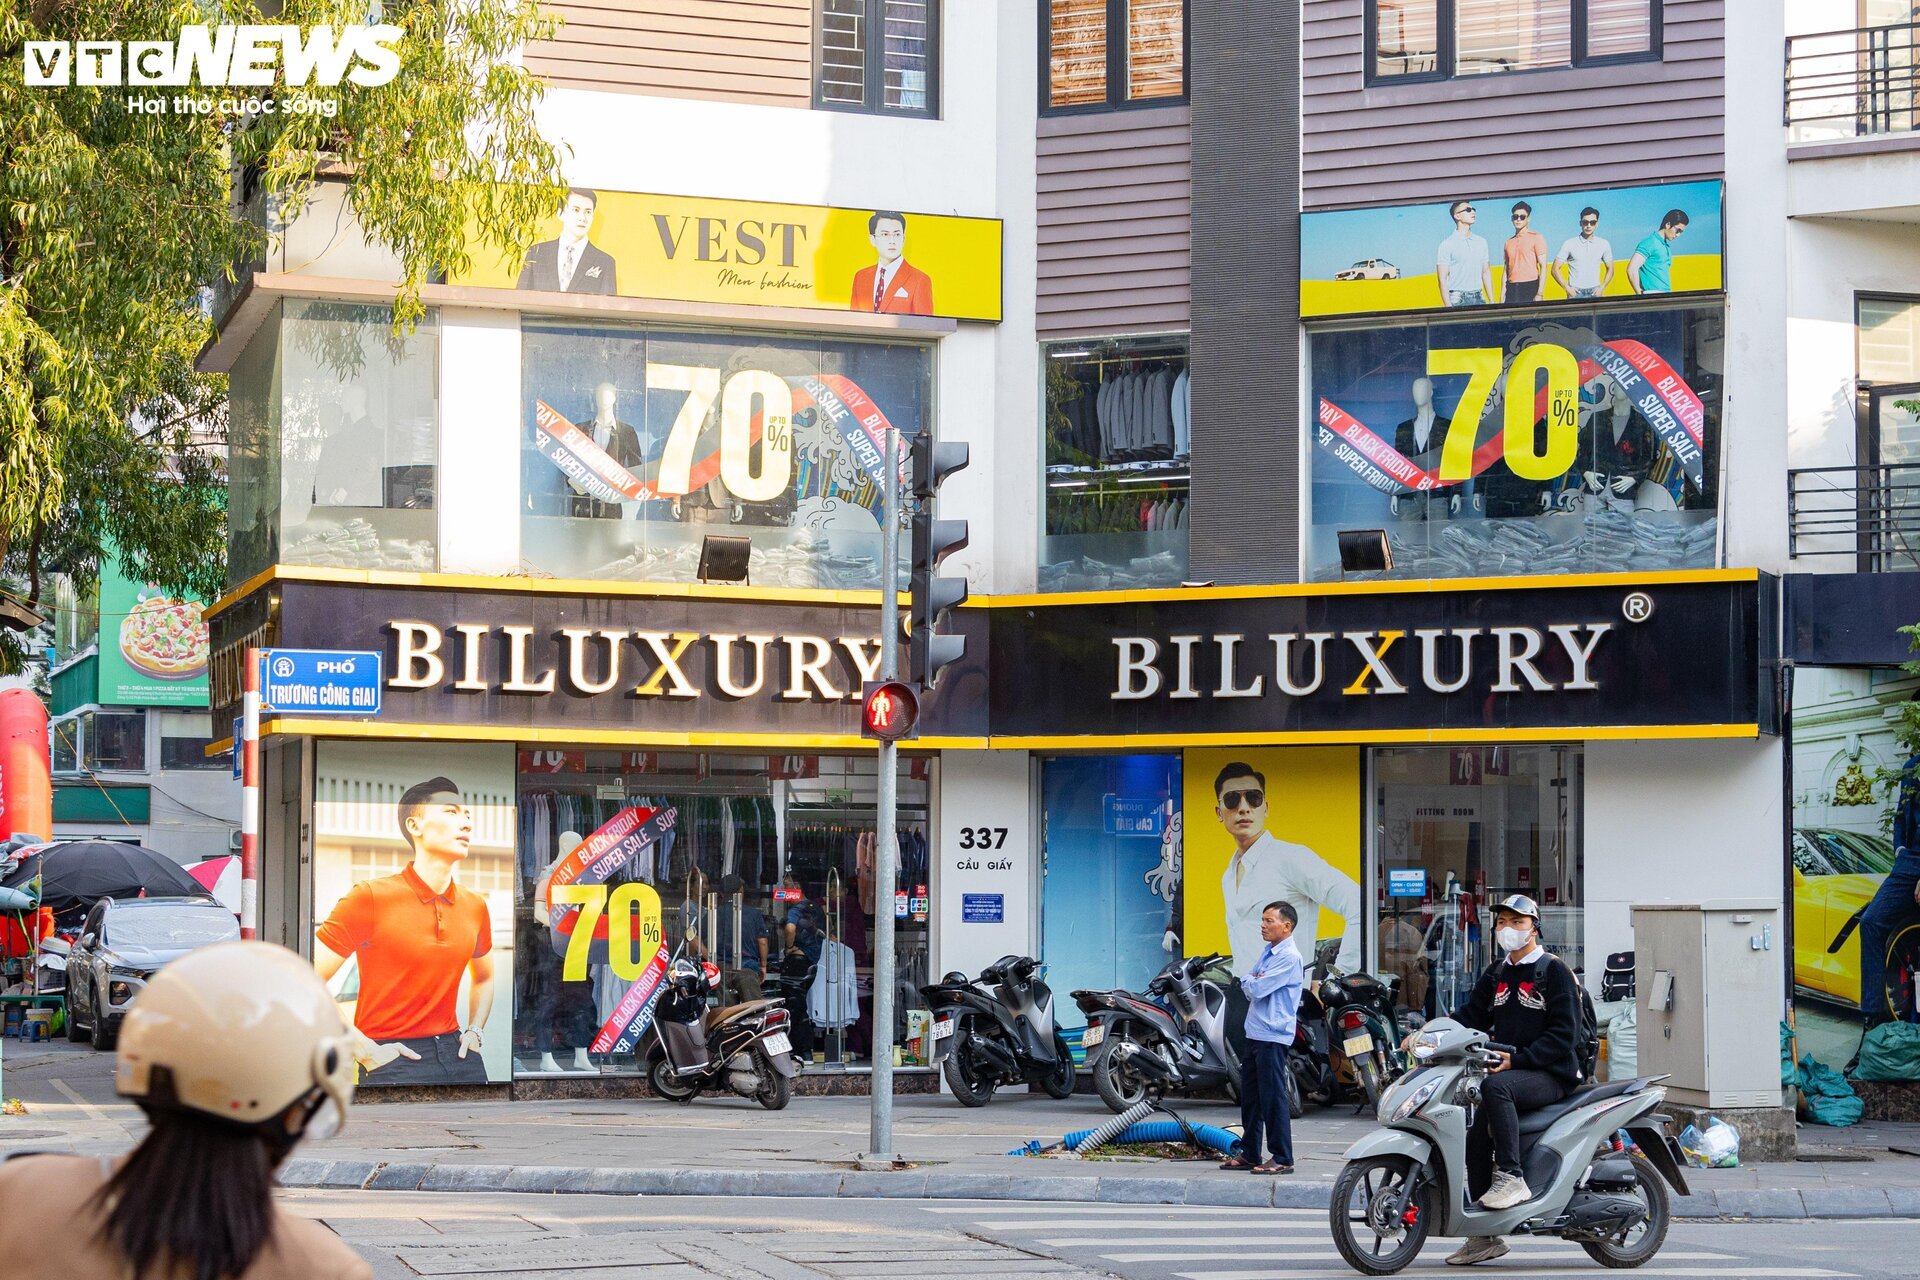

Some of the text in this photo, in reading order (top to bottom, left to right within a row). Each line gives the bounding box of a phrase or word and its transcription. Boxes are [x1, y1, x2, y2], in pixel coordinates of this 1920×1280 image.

[650, 214, 807, 268] VEST
[717, 268, 813, 290] Men fashion
[1426, 343, 1580, 481] 70
[1607, 358, 1641, 390] SALE
[1638, 394, 1676, 435] SUPER
[1667, 430, 1701, 464] SALE
[1656, 375, 1695, 415] BLACK
[645, 363, 792, 501] 70
[818, 391, 849, 422] SALE
[846, 428, 881, 468] SUPER
[1343, 424, 1383, 457] BLACK
[1377, 449, 1418, 482] FRIDAY
[550, 447, 585, 479] SUPER
[579, 474, 621, 501] FRIDAY
[1335, 443, 1369, 473] SUPER
[1362, 465, 1403, 495] FRIDAY
[317, 657, 357, 674] PHỐ
[387, 620, 884, 701] BILUXURY
[1110, 623, 1614, 700] BILUXURY
[271, 682, 376, 707] TRƯƠNG CÔNG GIAI
[1457, 752, 1473, 780] 70
[577, 832, 610, 867] BLACK
[606, 808, 641, 846] FRIDAY
[959, 827, 1009, 850] 337
[1416, 808, 1475, 816] FITTING ROOM
[592, 826, 651, 880] SUPER SALE
[957, 857, 1013, 870] CẦU GIẤY
[551, 882, 662, 982] 70
[611, 997, 639, 1029] BLACK
[634, 964, 663, 1001] FRIDAY
[628, 1007, 654, 1037] SUPER
